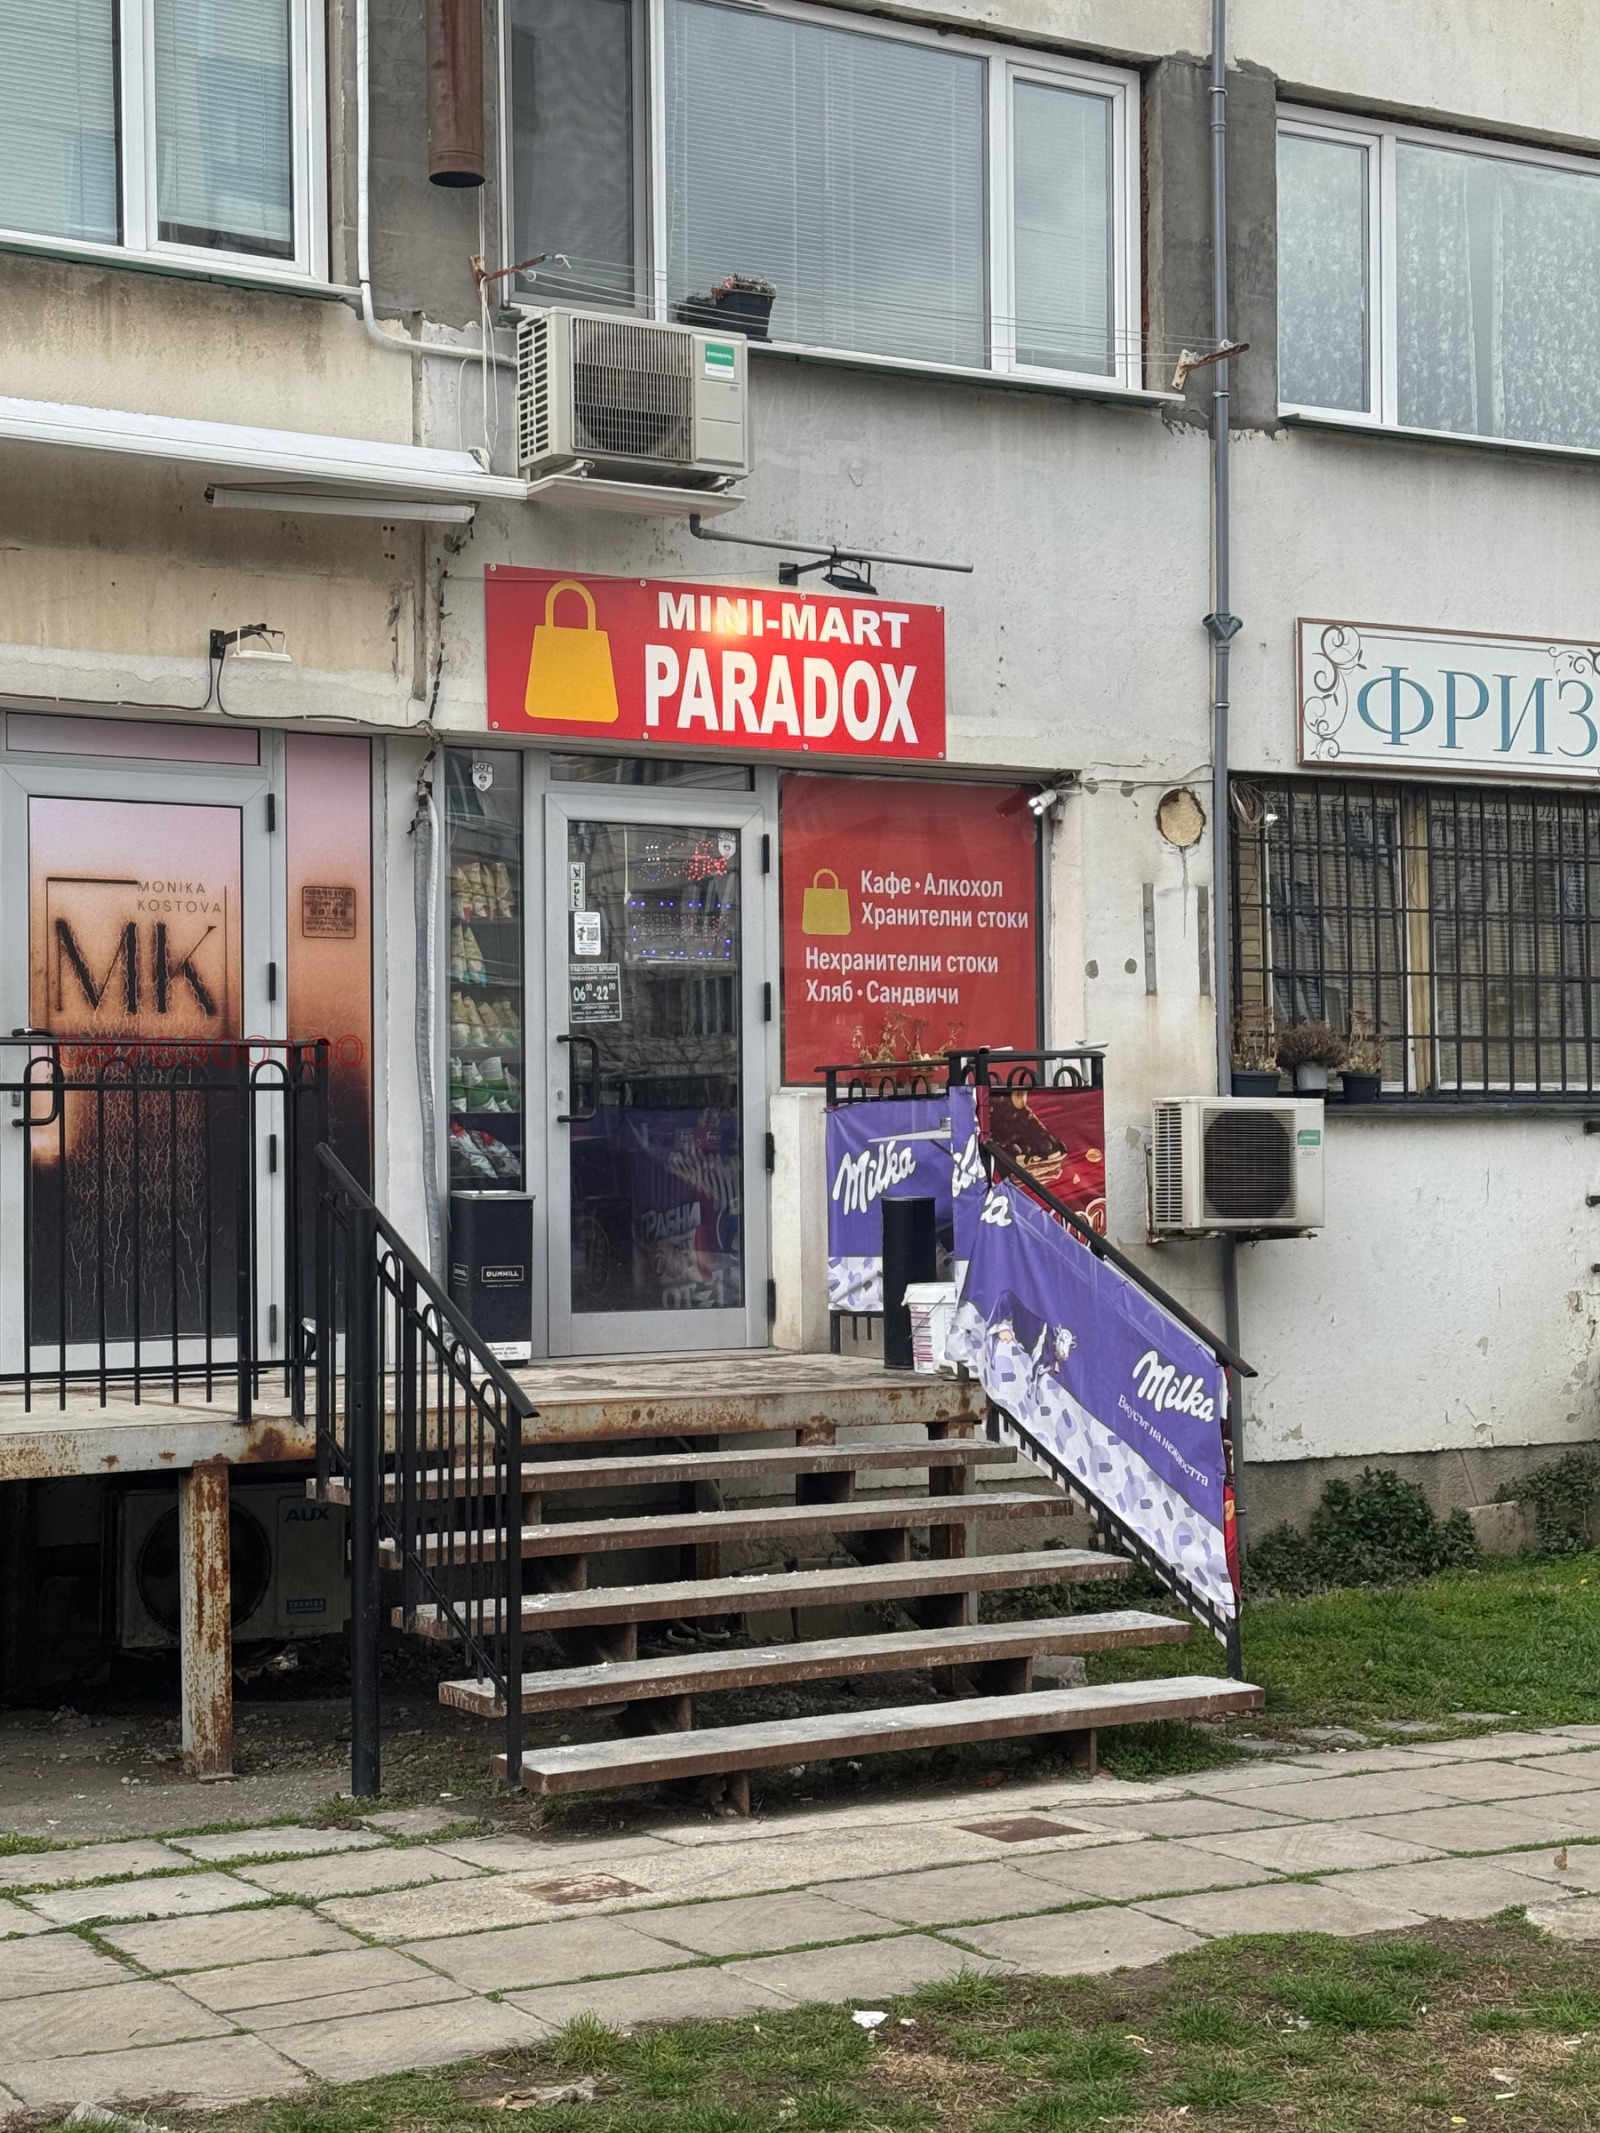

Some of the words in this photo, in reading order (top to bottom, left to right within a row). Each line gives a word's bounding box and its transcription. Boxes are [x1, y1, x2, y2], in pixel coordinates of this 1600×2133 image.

[658, 591, 910, 648] MINI-MART
[644, 644, 919, 743] PARADOX
[1357, 665, 1598, 757] ФРИЗ
[137, 881, 205, 894] MONIKA
[861, 870, 911, 899] Кафе
[924, 872, 1003, 897] Алкохол
[137, 899, 221, 913] KOSTOVA
[861, 902, 972, 930] Хранителни
[977, 911, 1029, 929] стоки
[805, 947, 942, 975] Нехранителни
[946, 955, 998, 973] стоки
[806, 979, 853, 1003] Хляб
[866, 980, 959, 1006] Сандвичи
[832, 1140, 916, 1216] Milka
[1132, 1350, 1215, 1422] Milka
[1117, 1394, 1150, 1431] Вкусът
[1149, 1426, 1162, 1443] на
[284, 1506, 330, 1521] AUX
